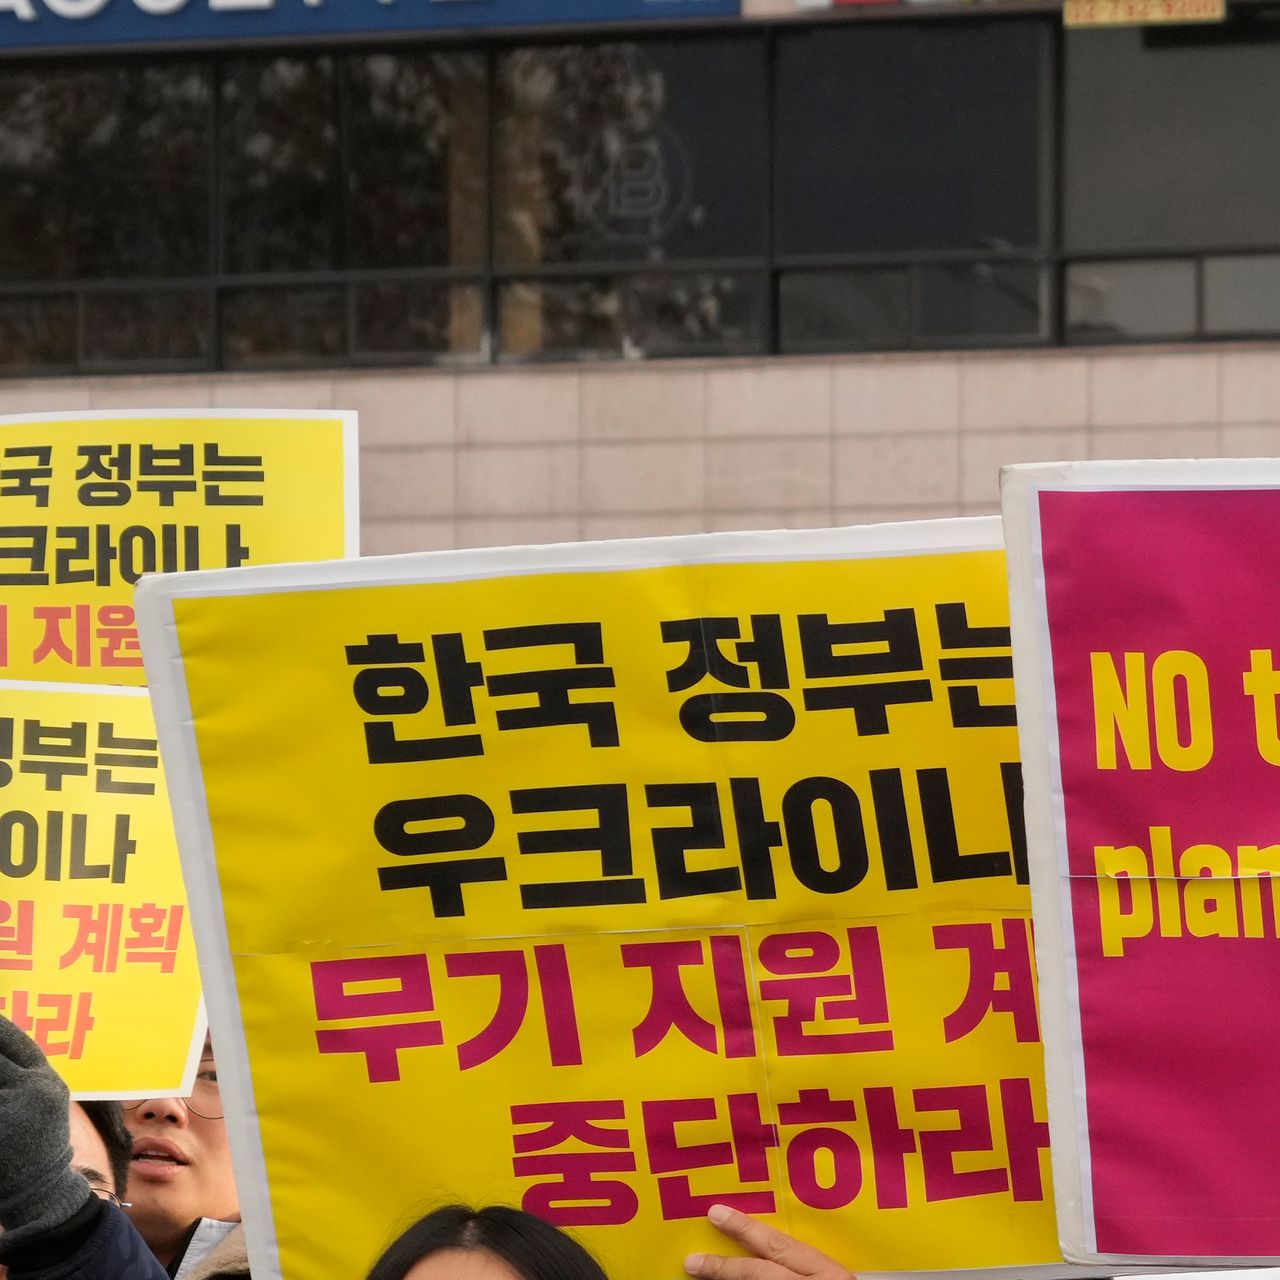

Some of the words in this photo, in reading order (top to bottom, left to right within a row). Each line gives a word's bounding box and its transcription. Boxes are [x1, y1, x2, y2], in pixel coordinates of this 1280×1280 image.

[1, 446, 52, 507] 국
[77, 444, 264, 506] 정부는
[0, 525, 249, 586] 크라이나
[345, 622, 619, 764] 한국
[660, 603, 1017, 742] 정부는
[1091, 651, 1213, 771] NO
[0, 809, 137, 884] 이나
[374, 762, 1030, 917] 우크라이나
[60, 904, 183, 972] 계획
[311, 944, 584, 1083] 무기
[621, 926, 895, 1059] 지원
[511, 1077, 1050, 1227] 중단하라
